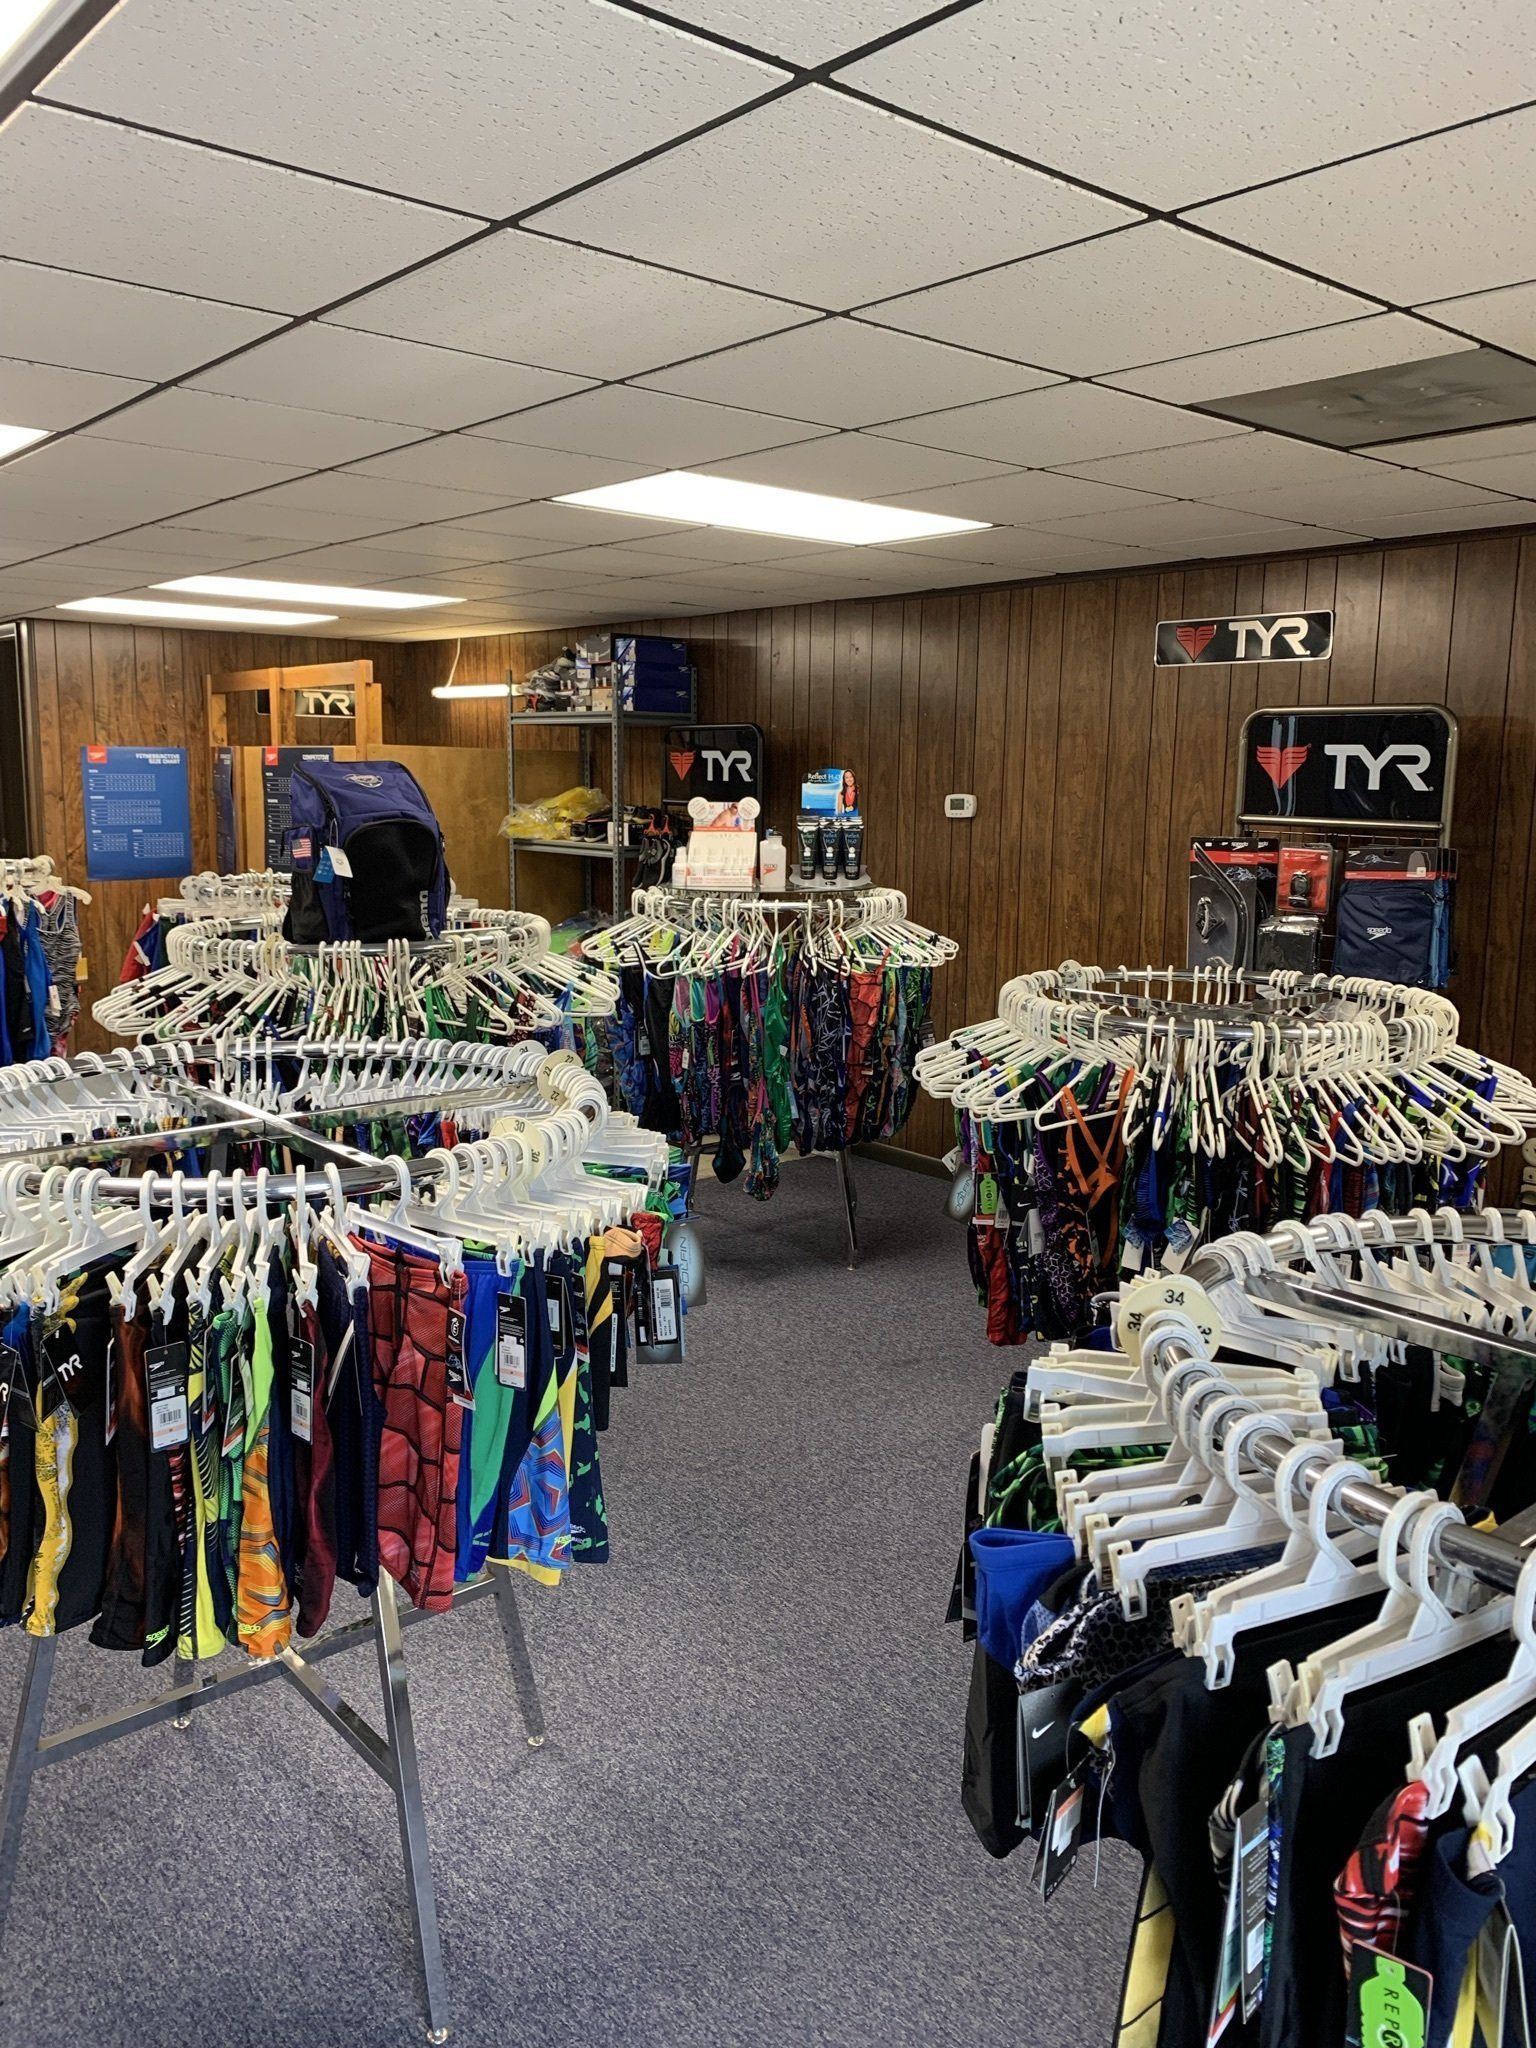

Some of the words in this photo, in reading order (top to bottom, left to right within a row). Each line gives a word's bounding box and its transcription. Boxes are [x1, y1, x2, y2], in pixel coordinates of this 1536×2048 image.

[1229, 617, 1310, 658] TYR
[303, 691, 351, 715] TYR
[701, 750, 753, 782] TYR
[1324, 744, 1432, 791] TYR
[1366, 926, 1392, 935] speedo
[514, 1120, 525, 1133] 30
[679, 1236, 690, 1296] DOLFIN
[1164, 1289, 1185, 1306] 34
[1127, 1312, 1144, 1332] 34
[57, 1354, 83, 1381] TYR
